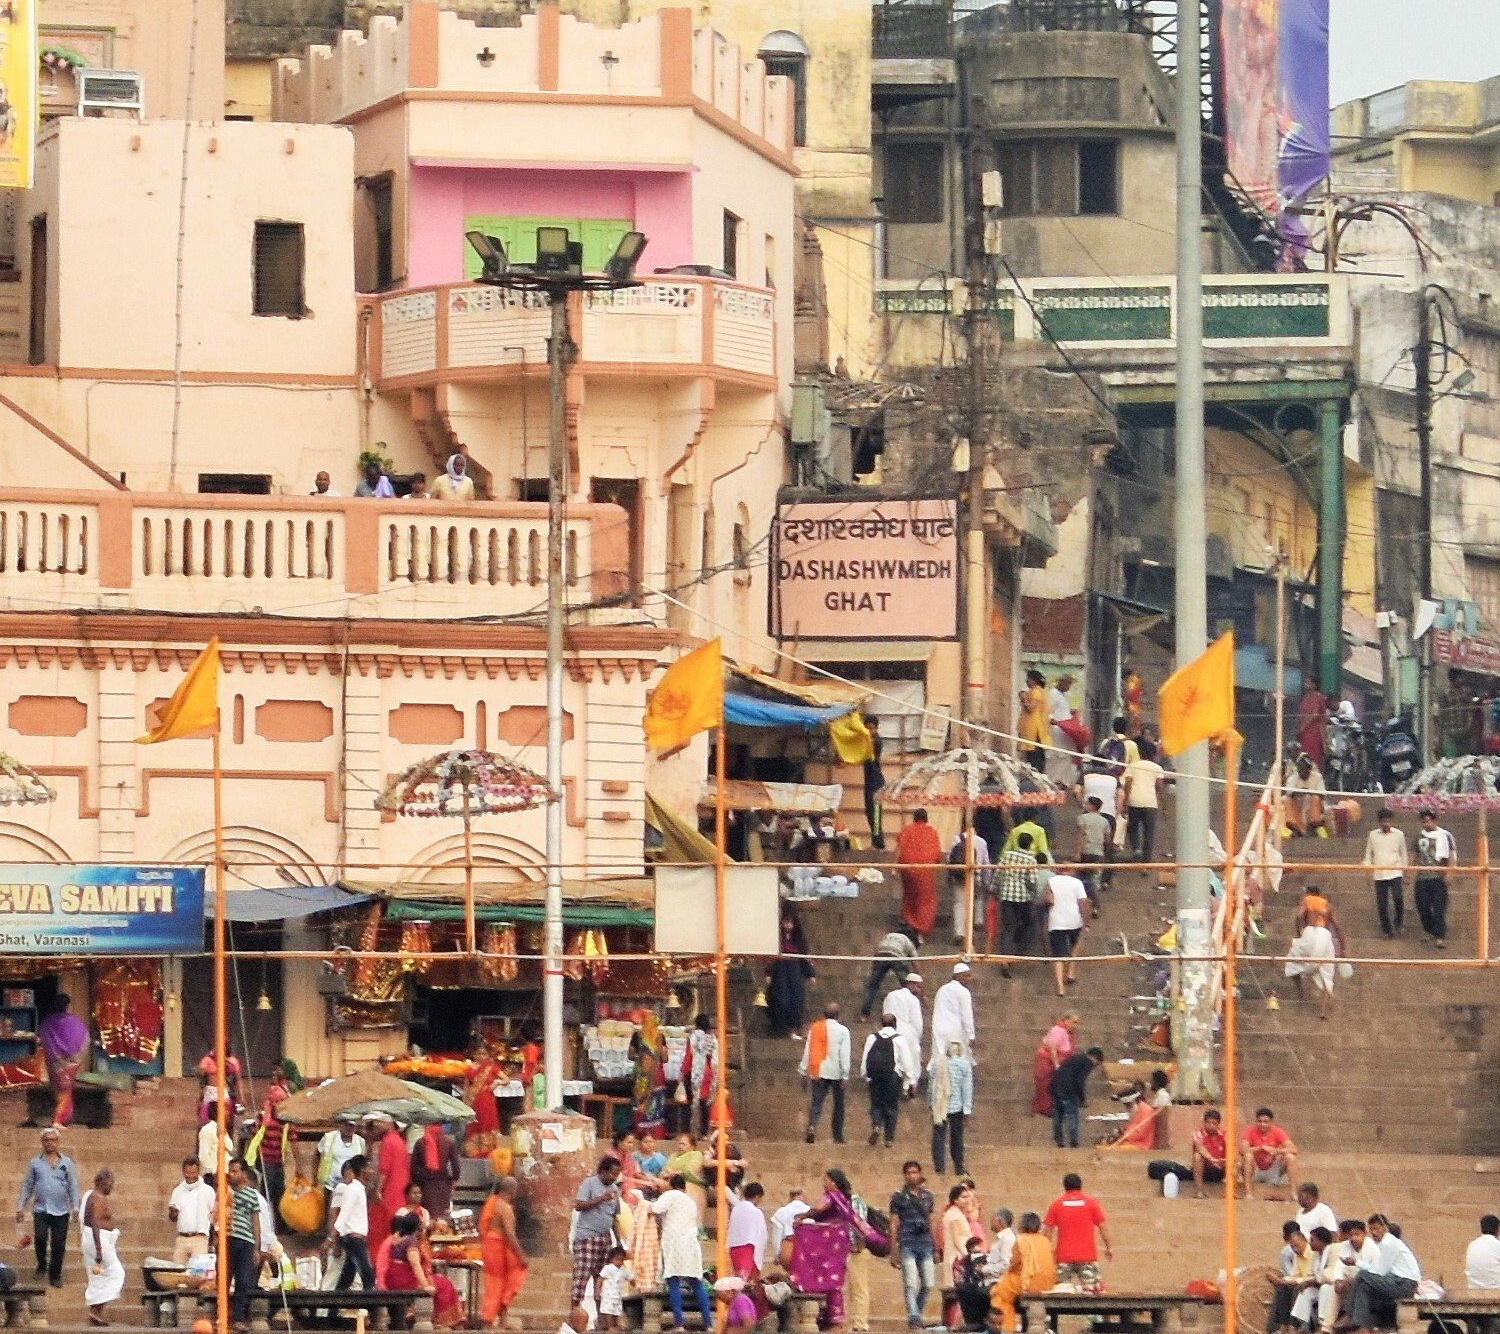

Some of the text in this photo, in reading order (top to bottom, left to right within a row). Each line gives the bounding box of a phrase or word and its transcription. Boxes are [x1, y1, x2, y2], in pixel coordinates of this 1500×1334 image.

[783, 509, 955, 544] दशाश्वमेध घाट
[780, 559, 951, 581] DASHASHWMEDH
[825, 591, 892, 612] GHAT
[60, 883, 176, 916] SAMITI
[34, 934, 90, 947] Varanasi
